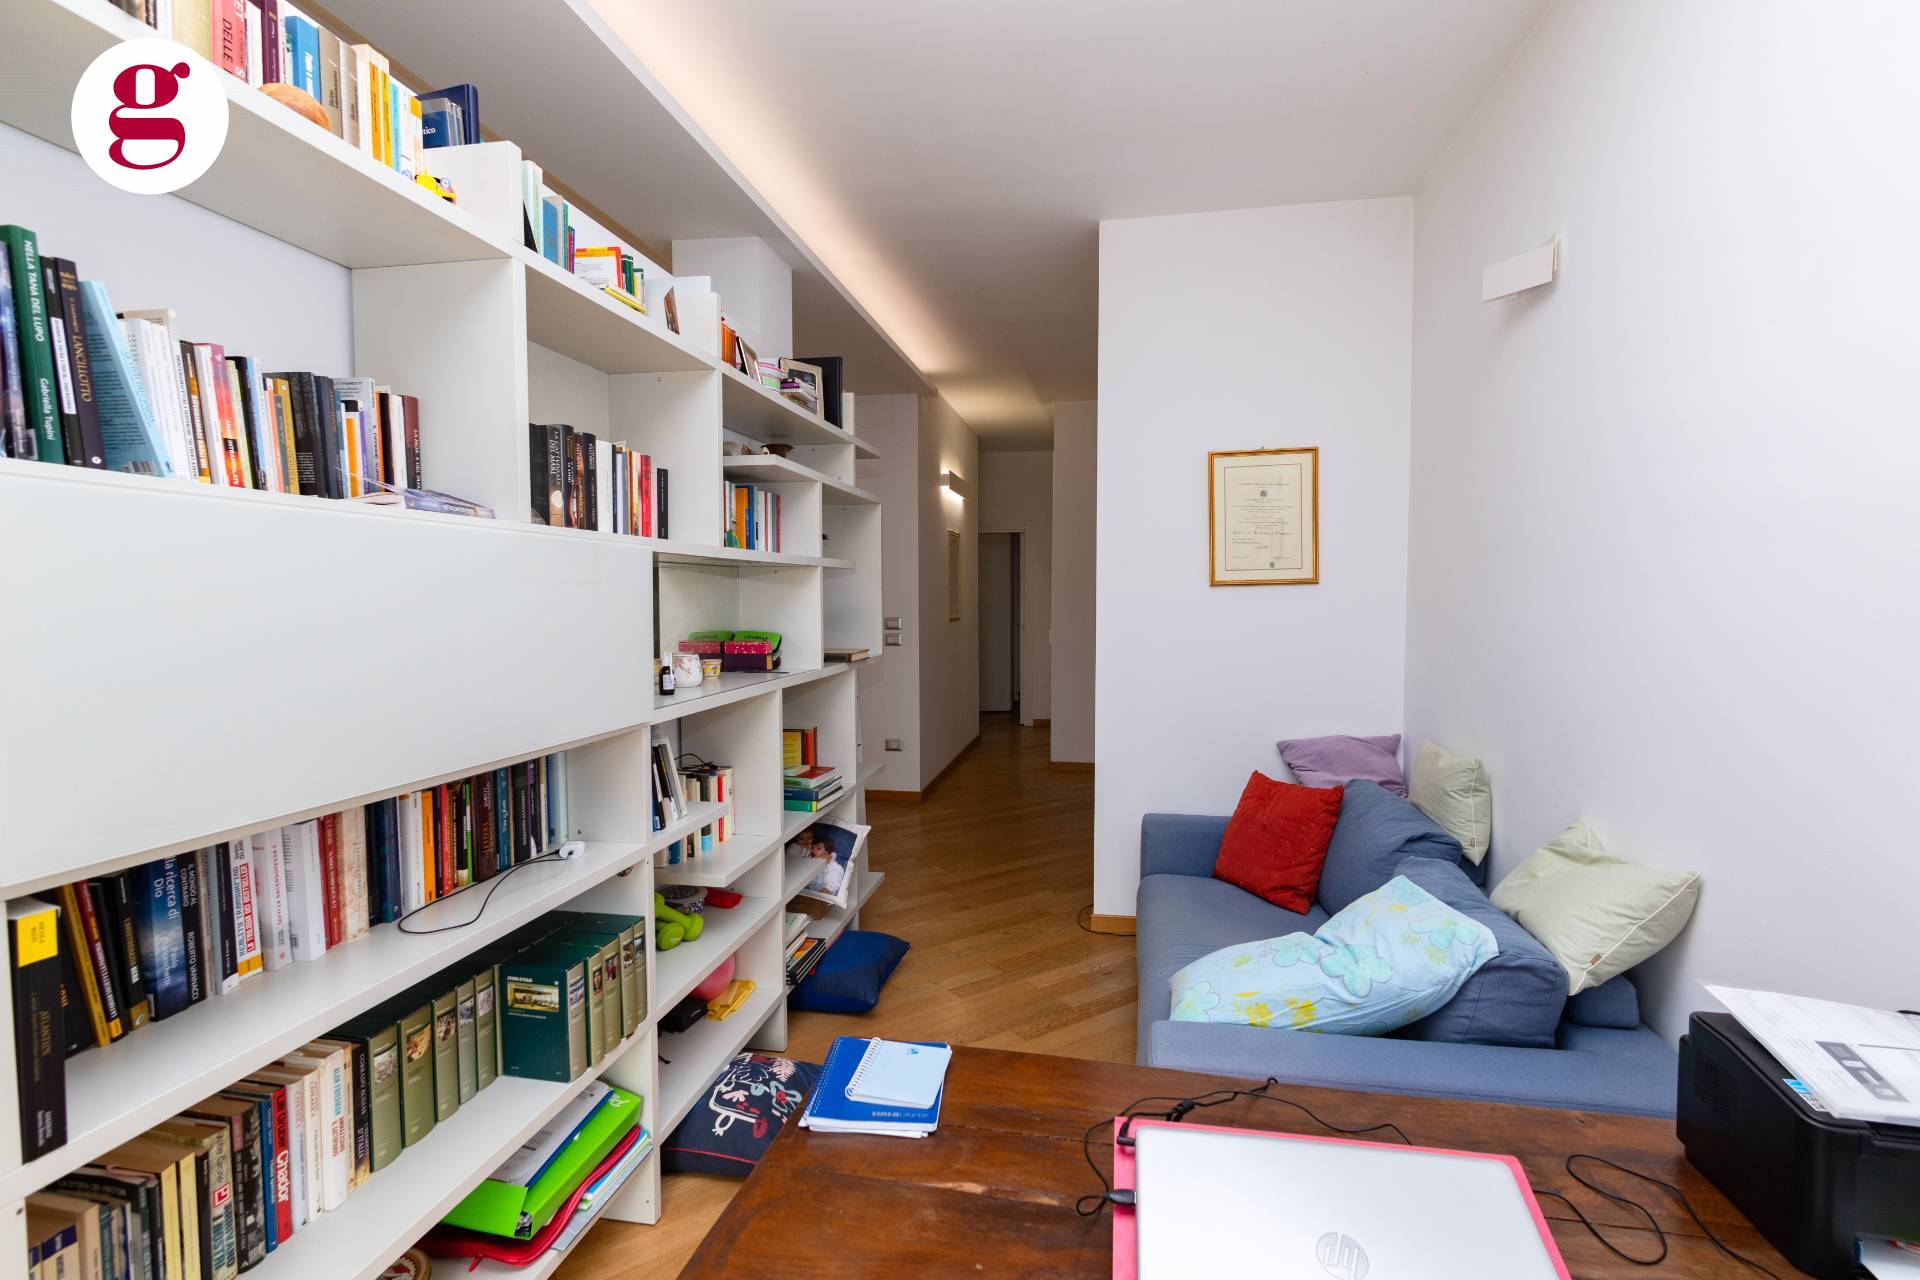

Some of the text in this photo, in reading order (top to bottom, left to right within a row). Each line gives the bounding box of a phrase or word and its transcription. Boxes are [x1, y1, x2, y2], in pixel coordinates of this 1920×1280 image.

[223, 19, 233, 62] DELLE
[24, 240, 44, 342] NELLA TANA DEL LUPO
[72, 335, 92, 402] LANCILLOTTO
[40, 378, 55, 440] Gabriella Tupini
[554, 431, 560, 439] LA
[154, 878, 164, 897] Dio
[166, 872, 177, 907] ricerca
[180, 868, 189, 907] CONTRARIO
[190, 898, 196, 906] AL
[168, 909, 179, 919] di
[187, 931, 198, 1000] ROBERTO VANNACCI
[332, 1067, 343, 1115] ALAN FRIEDMAN
[358, 1053, 367, 1087] CORRADO
[356, 1127, 365, 1159] D'ITALIA
[277, 1151, 290, 1203] Chador
[212, 1224, 225, 1271] NOSTRI
[223, 1205, 235, 1269] ARRIVANO
